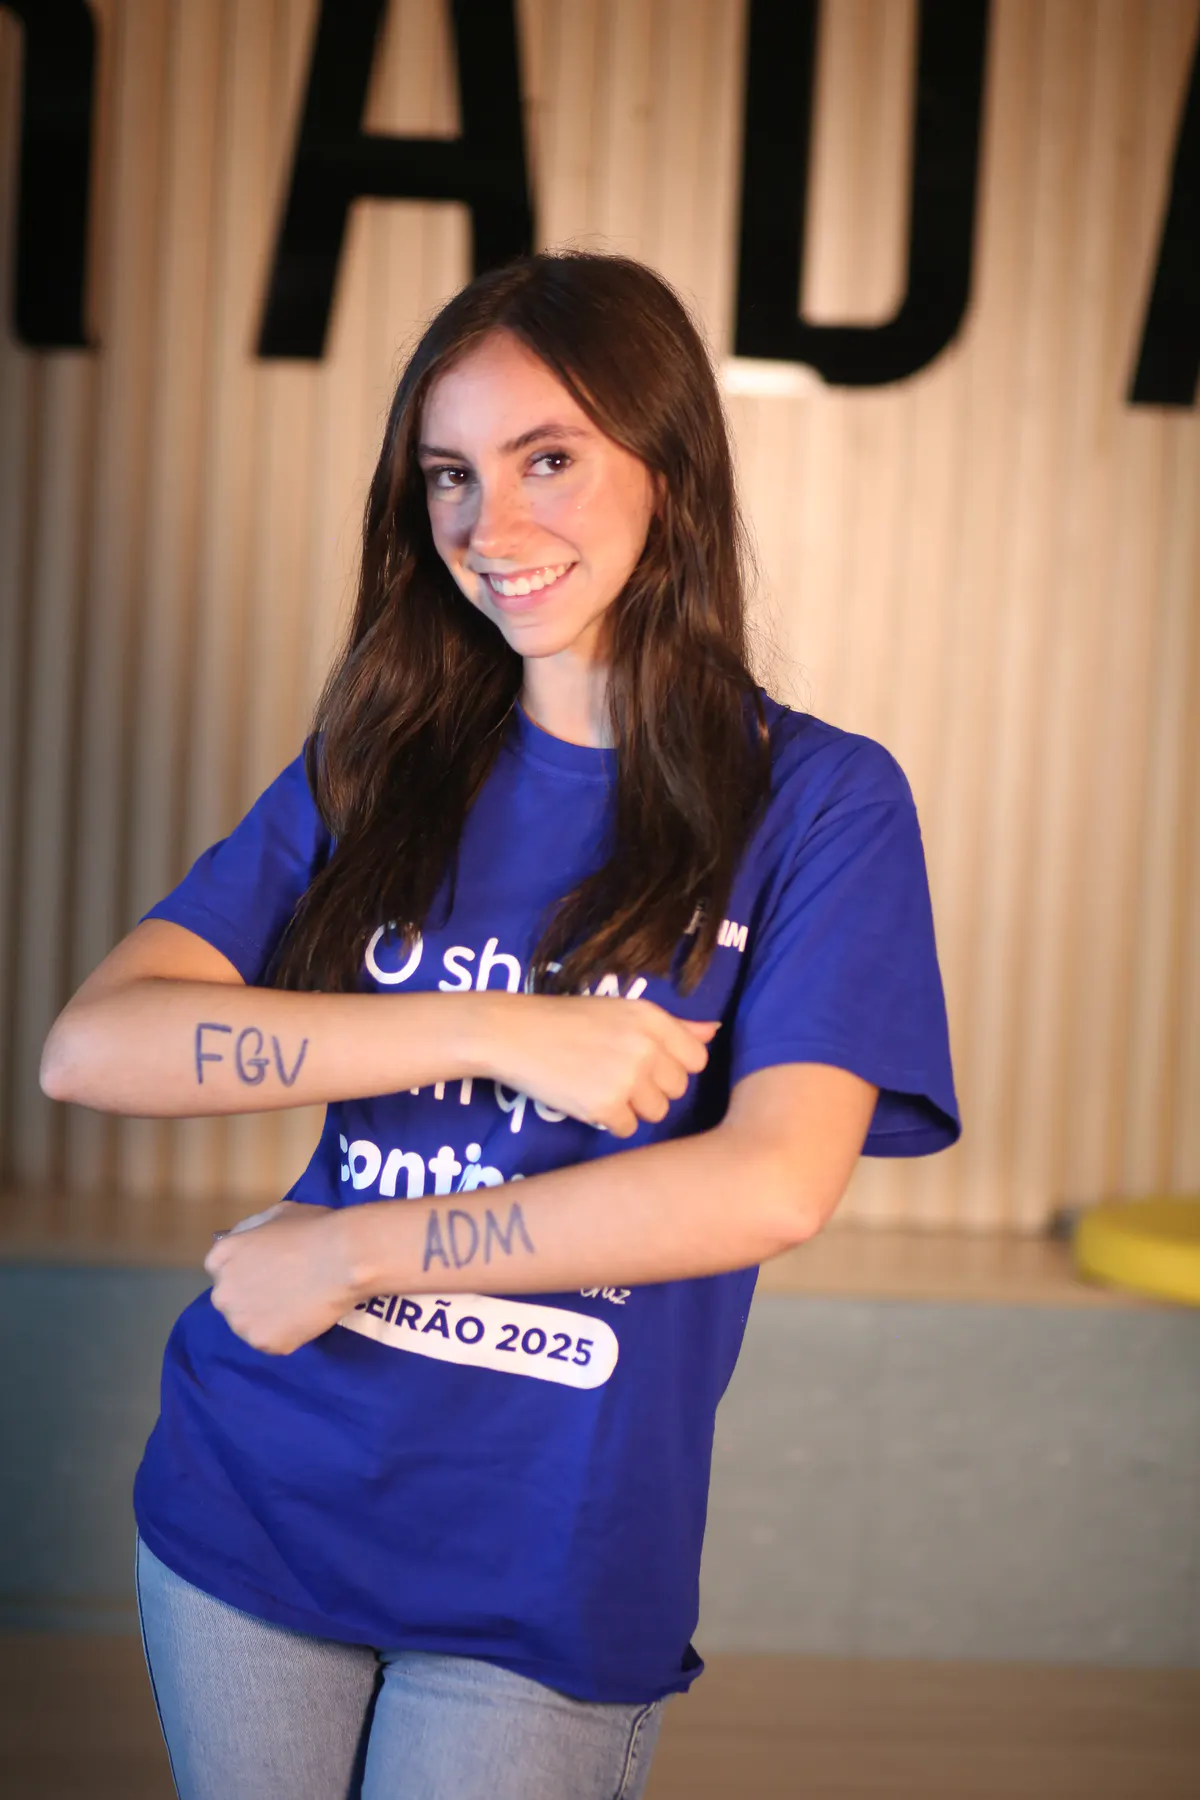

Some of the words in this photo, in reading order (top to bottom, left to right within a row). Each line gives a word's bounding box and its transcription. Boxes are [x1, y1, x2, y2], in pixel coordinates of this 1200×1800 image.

[365, 920, 424, 985] O
[438, 937, 648, 1000] sh
[195, 1022, 309, 1088] FGV
[422, 1202, 535, 1273] ADM
[354, 1294, 485, 1345] EIRÃO
[495, 1323, 595, 1367] 2025
